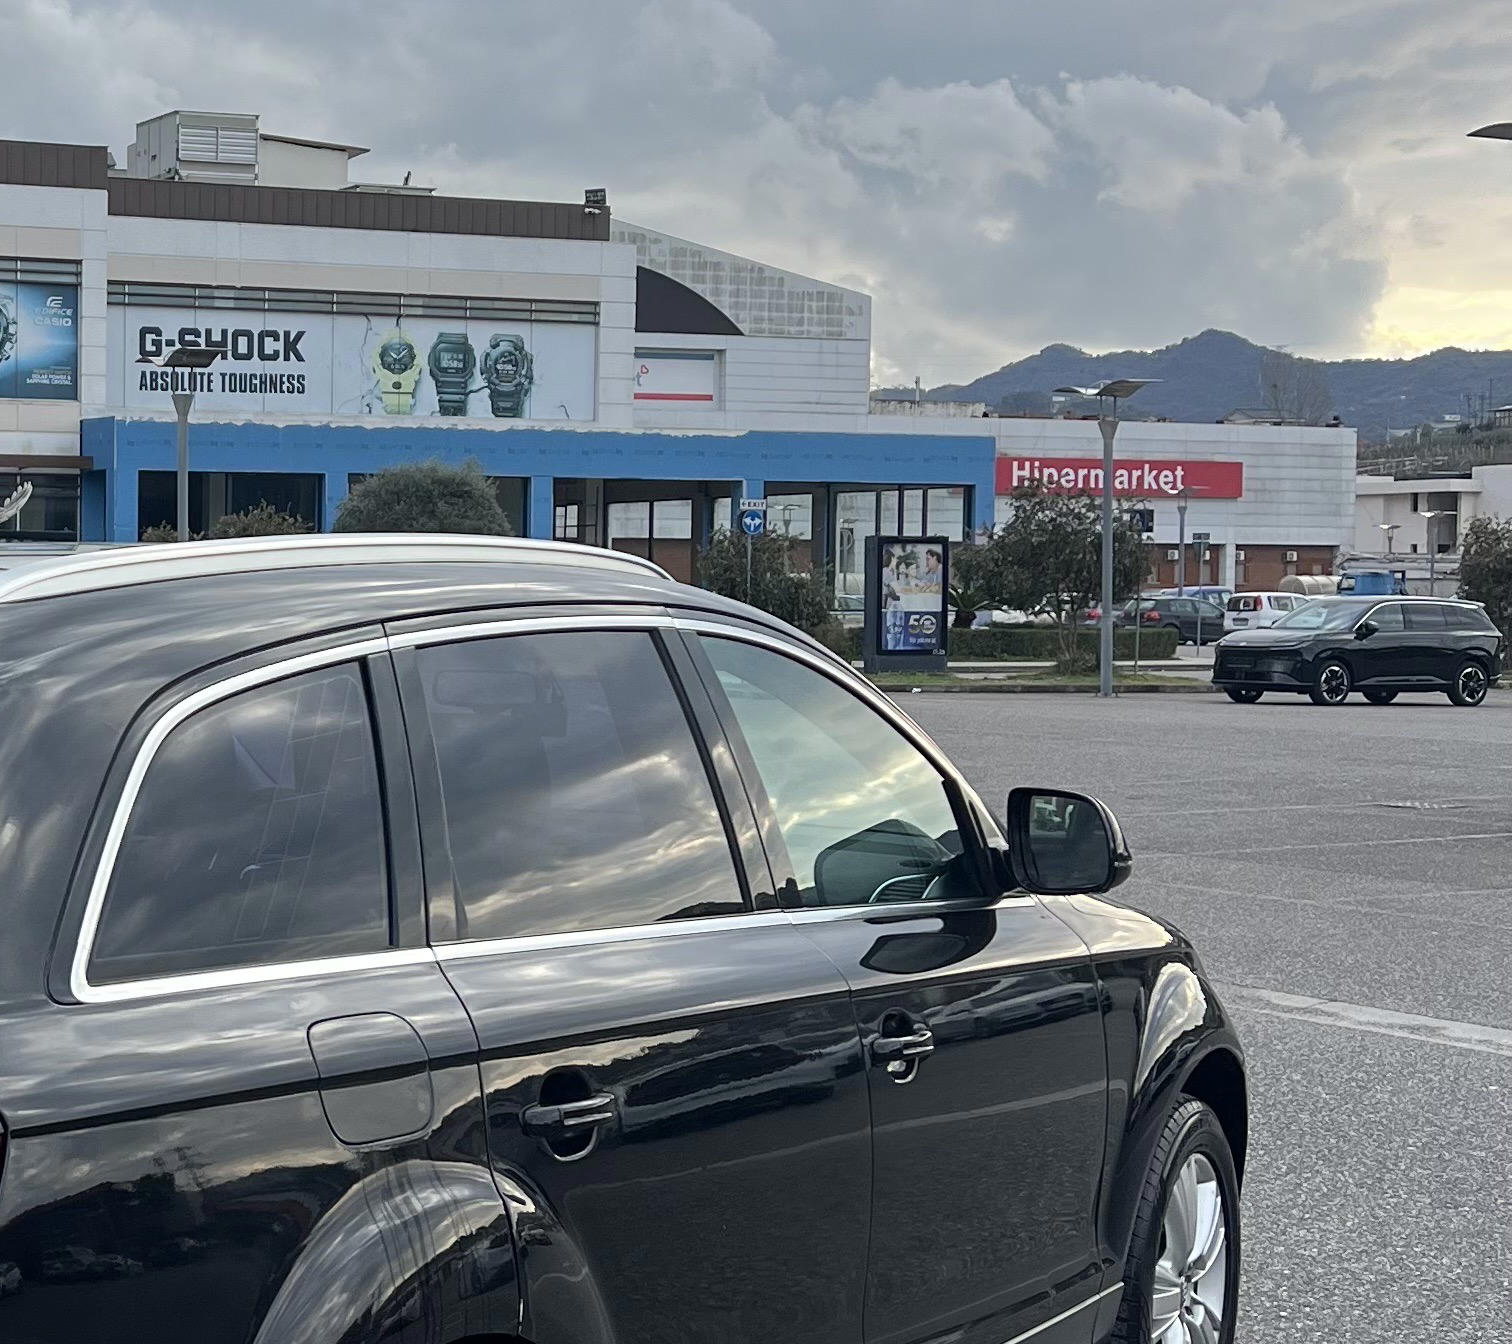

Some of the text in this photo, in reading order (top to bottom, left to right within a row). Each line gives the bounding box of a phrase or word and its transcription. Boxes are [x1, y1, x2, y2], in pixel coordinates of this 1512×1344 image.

[139, 326, 306, 362] G-SHOCK
[139, 370, 306, 394] ABSOLUTE TOUGHNESS
[1012, 460, 1185, 490] Hipermarket
